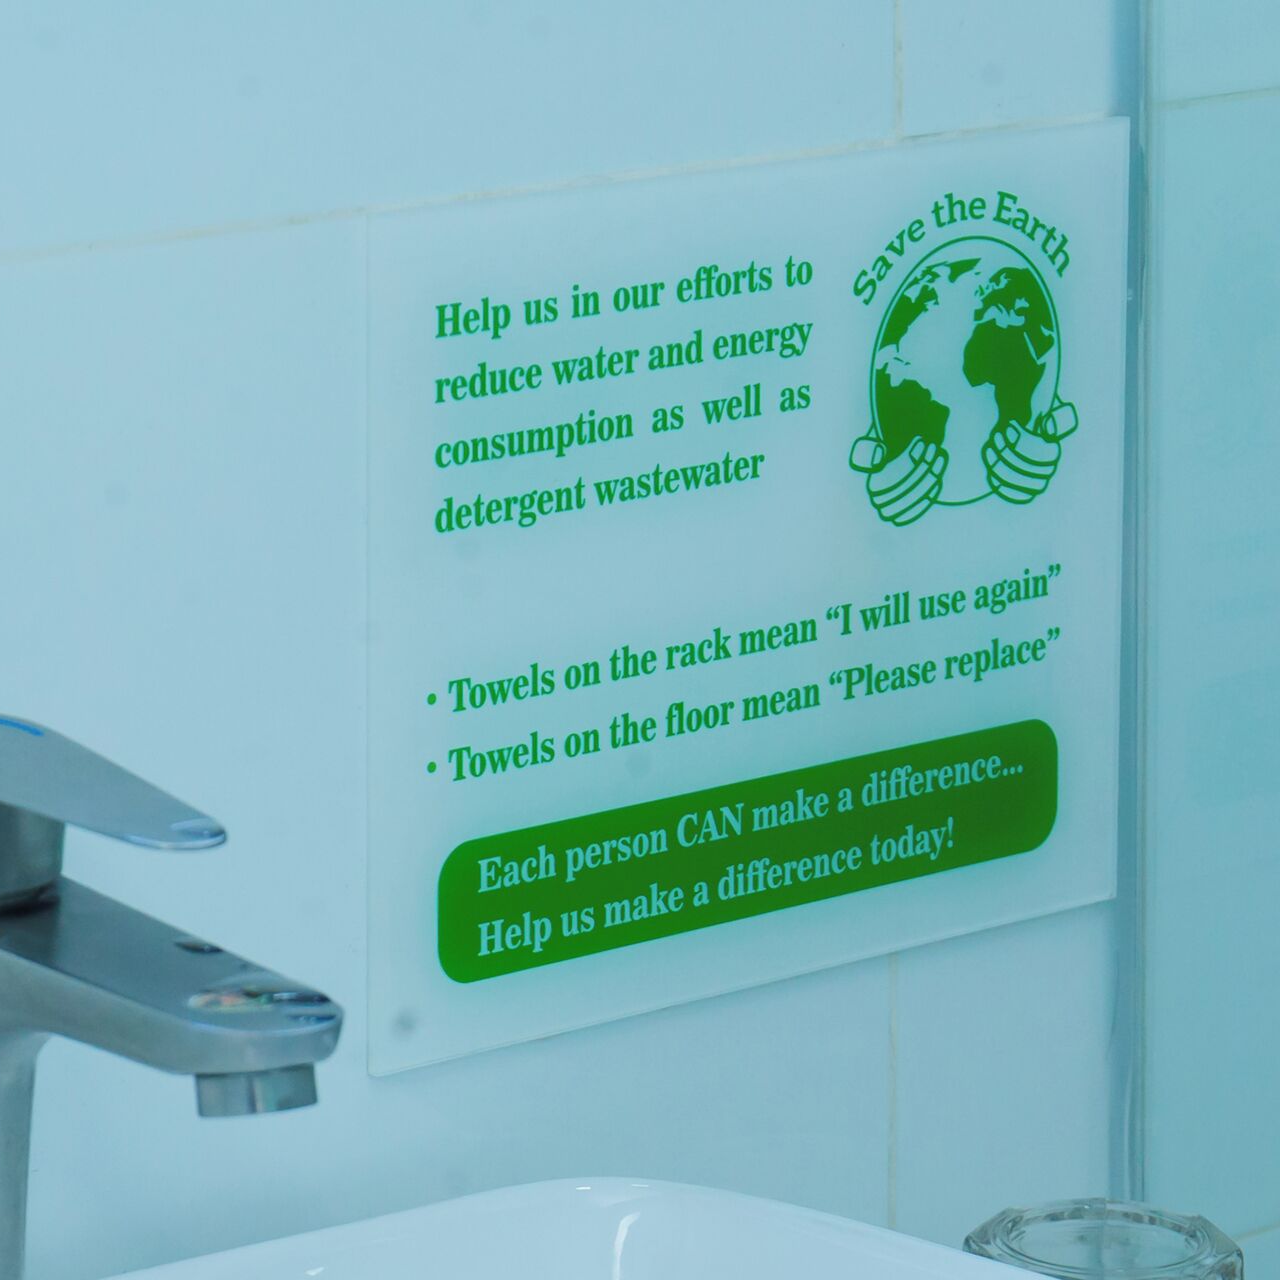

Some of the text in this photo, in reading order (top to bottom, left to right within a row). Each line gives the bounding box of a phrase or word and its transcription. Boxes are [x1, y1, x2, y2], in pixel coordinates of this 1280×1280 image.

[435, 256, 813, 341] Help us in our efforts to
[852, 191, 1071, 306] Save the Earth
[435, 322, 813, 404] reduce water and energy
[435, 383, 813, 469] consumption as well as
[435, 450, 766, 534] detergent wastewater
[448, 563, 1062, 712] Towels on the rack mean “I will use again”
[448, 626, 1061, 782] Towels on the floor mean “Please replace”
[479, 756, 1023, 892] Each person CAN make a difference...
[479, 817, 953, 955] Help us make a difference today!
